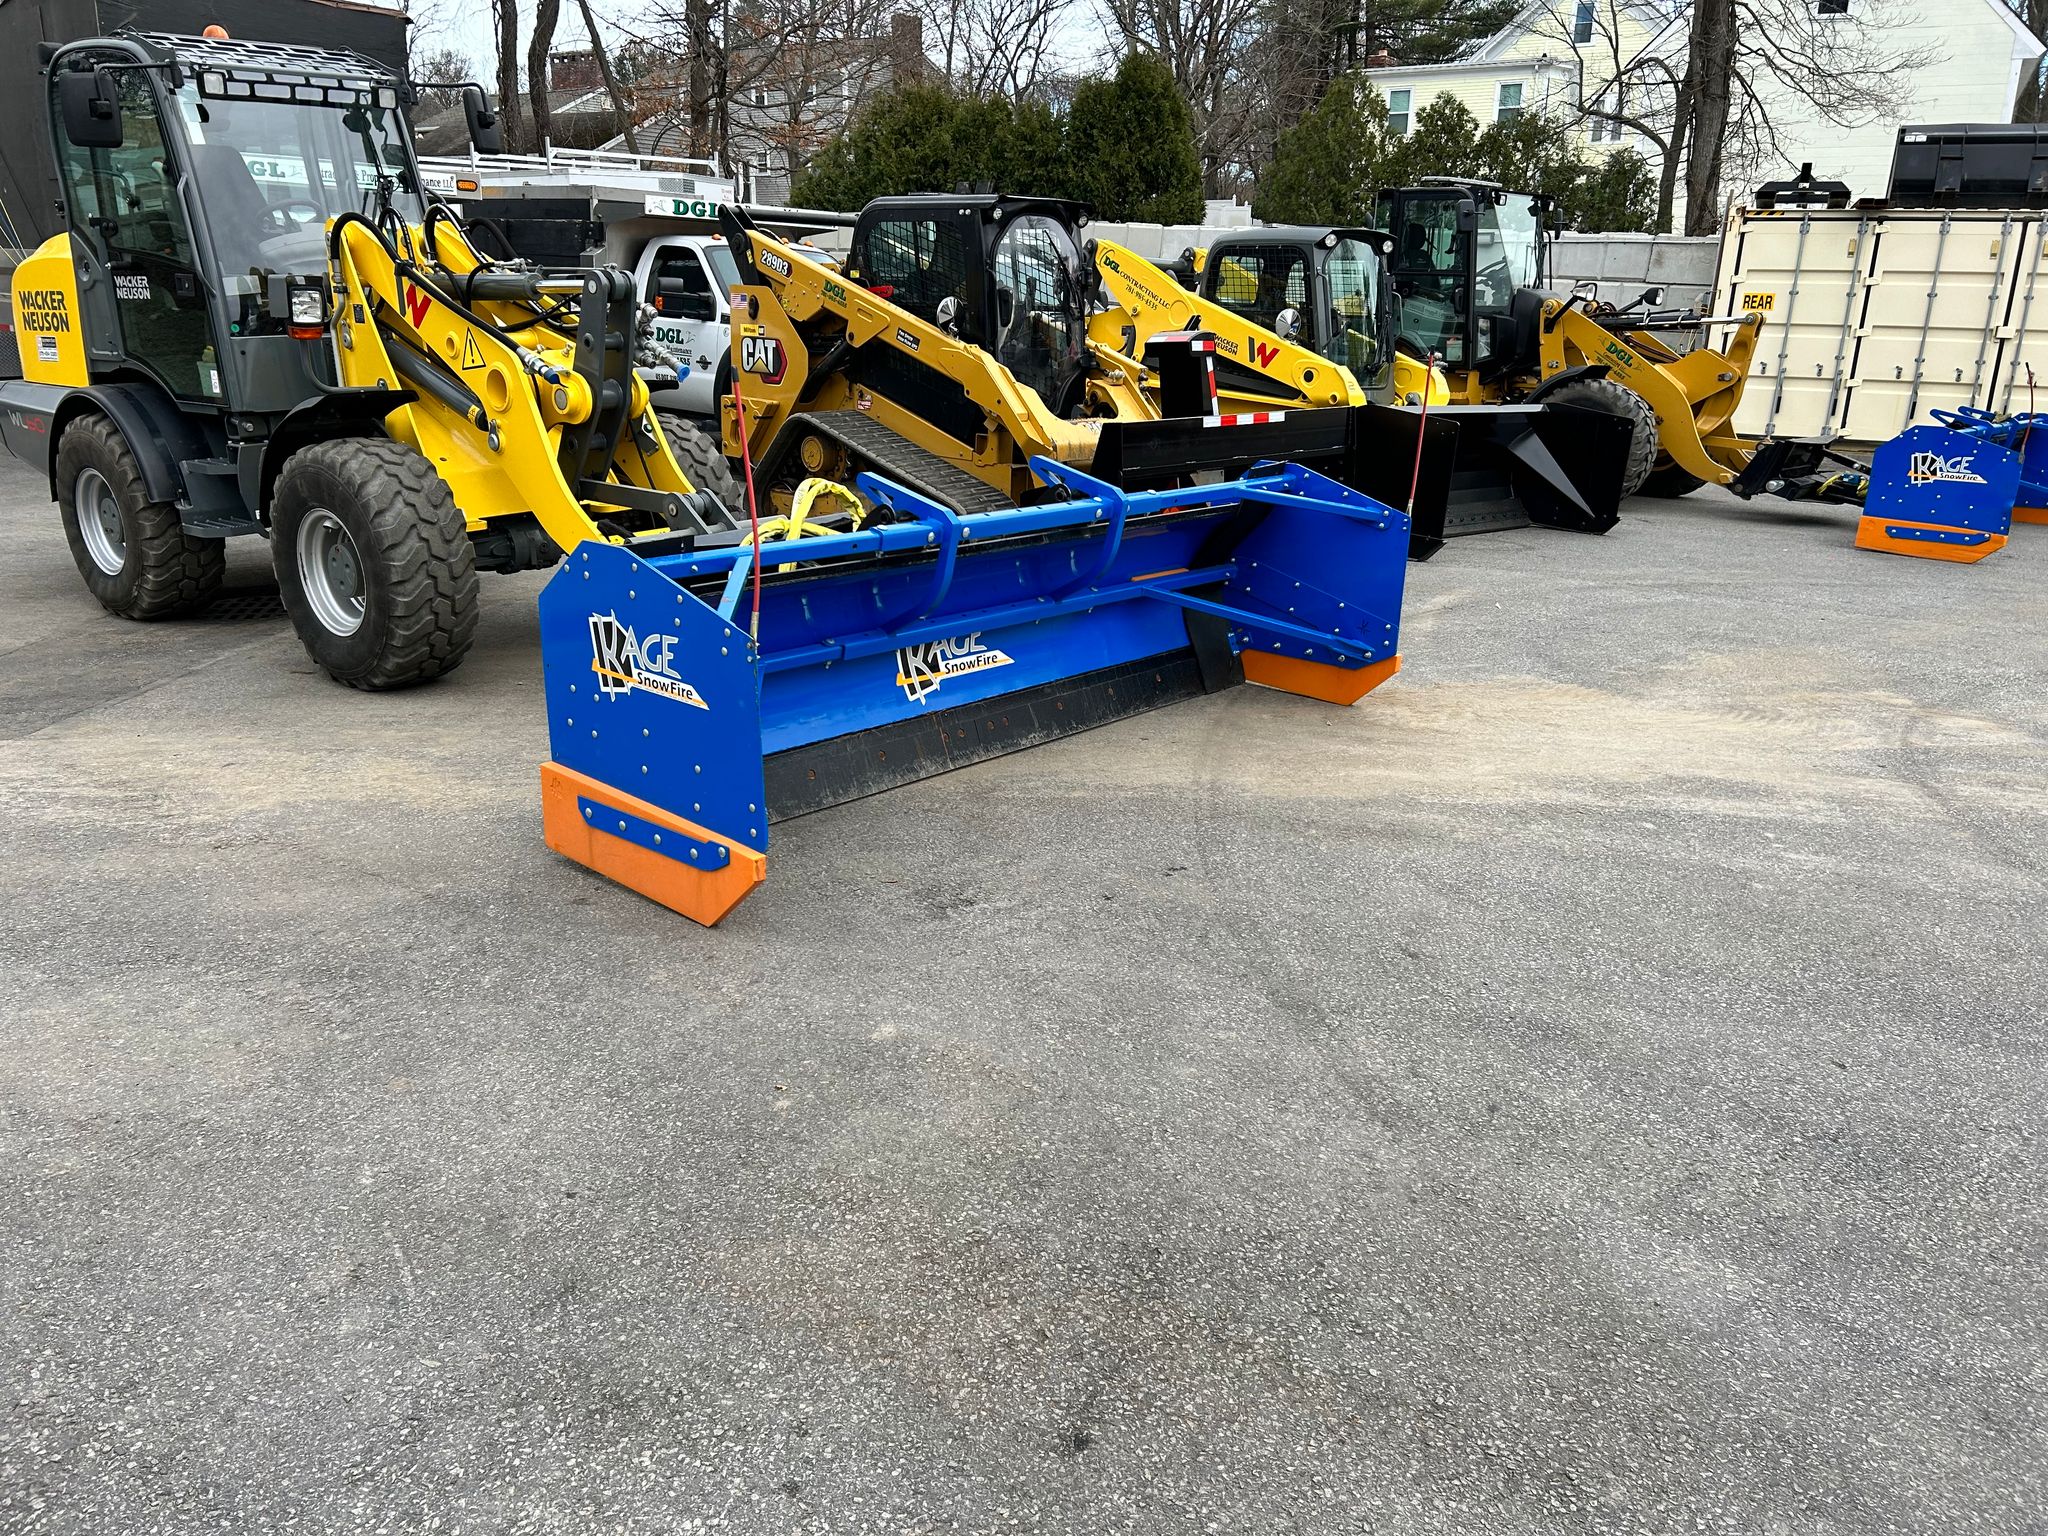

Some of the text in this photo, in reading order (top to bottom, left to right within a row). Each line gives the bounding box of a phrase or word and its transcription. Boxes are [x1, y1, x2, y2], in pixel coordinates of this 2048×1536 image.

[247, 160, 286, 178] GL
[761, 249, 789, 277] 289D3
[114, 275, 150, 288] WACKER
[823, 279, 847, 302] DGL
[1103, 255, 1171, 310] DGL CONTRACTING LLC
[18, 290, 67, 311] WACKER
[116, 288, 151, 299] NEUSON
[1742, 295, 1773, 310] REAR
[22, 312, 70, 332] NEUSON
[655, 327, 684, 344] DGL
[742, 337, 777, 374] CAT
[1606, 341, 1634, 367] DGL
[1915, 450, 1976, 488] KAGE
[1940, 473, 1978, 481] SnowFire
[592, 608, 682, 703] KAGE
[945, 654, 998, 675] SnowFire
[637, 671, 693, 700] SnowFire
